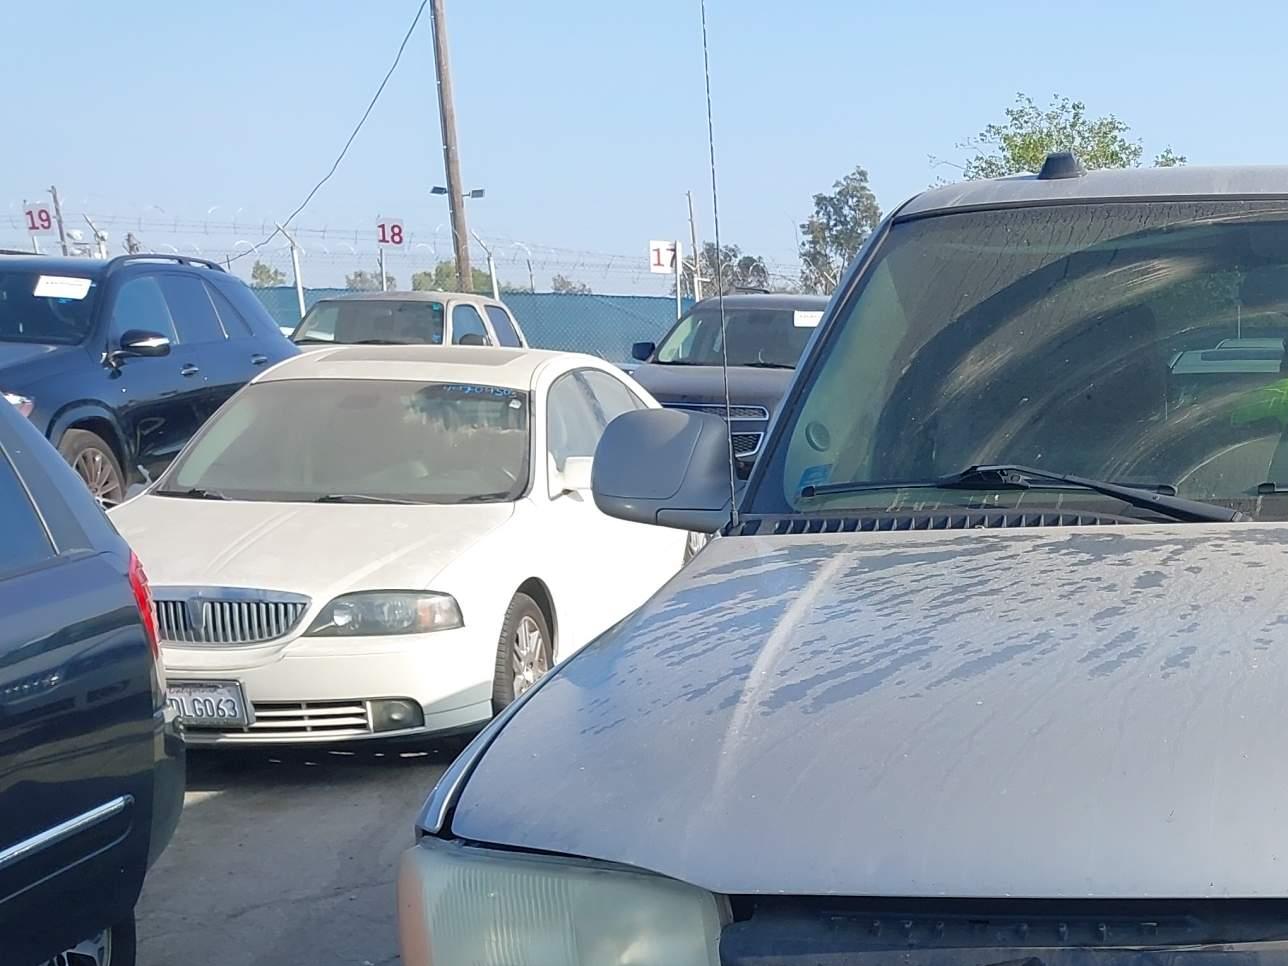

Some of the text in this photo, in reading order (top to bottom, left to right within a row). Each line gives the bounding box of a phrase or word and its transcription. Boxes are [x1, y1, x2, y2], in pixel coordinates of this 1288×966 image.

[25, 209, 52, 230] 19
[377, 223, 404, 245] 18
[651, 247, 676, 268] 17
